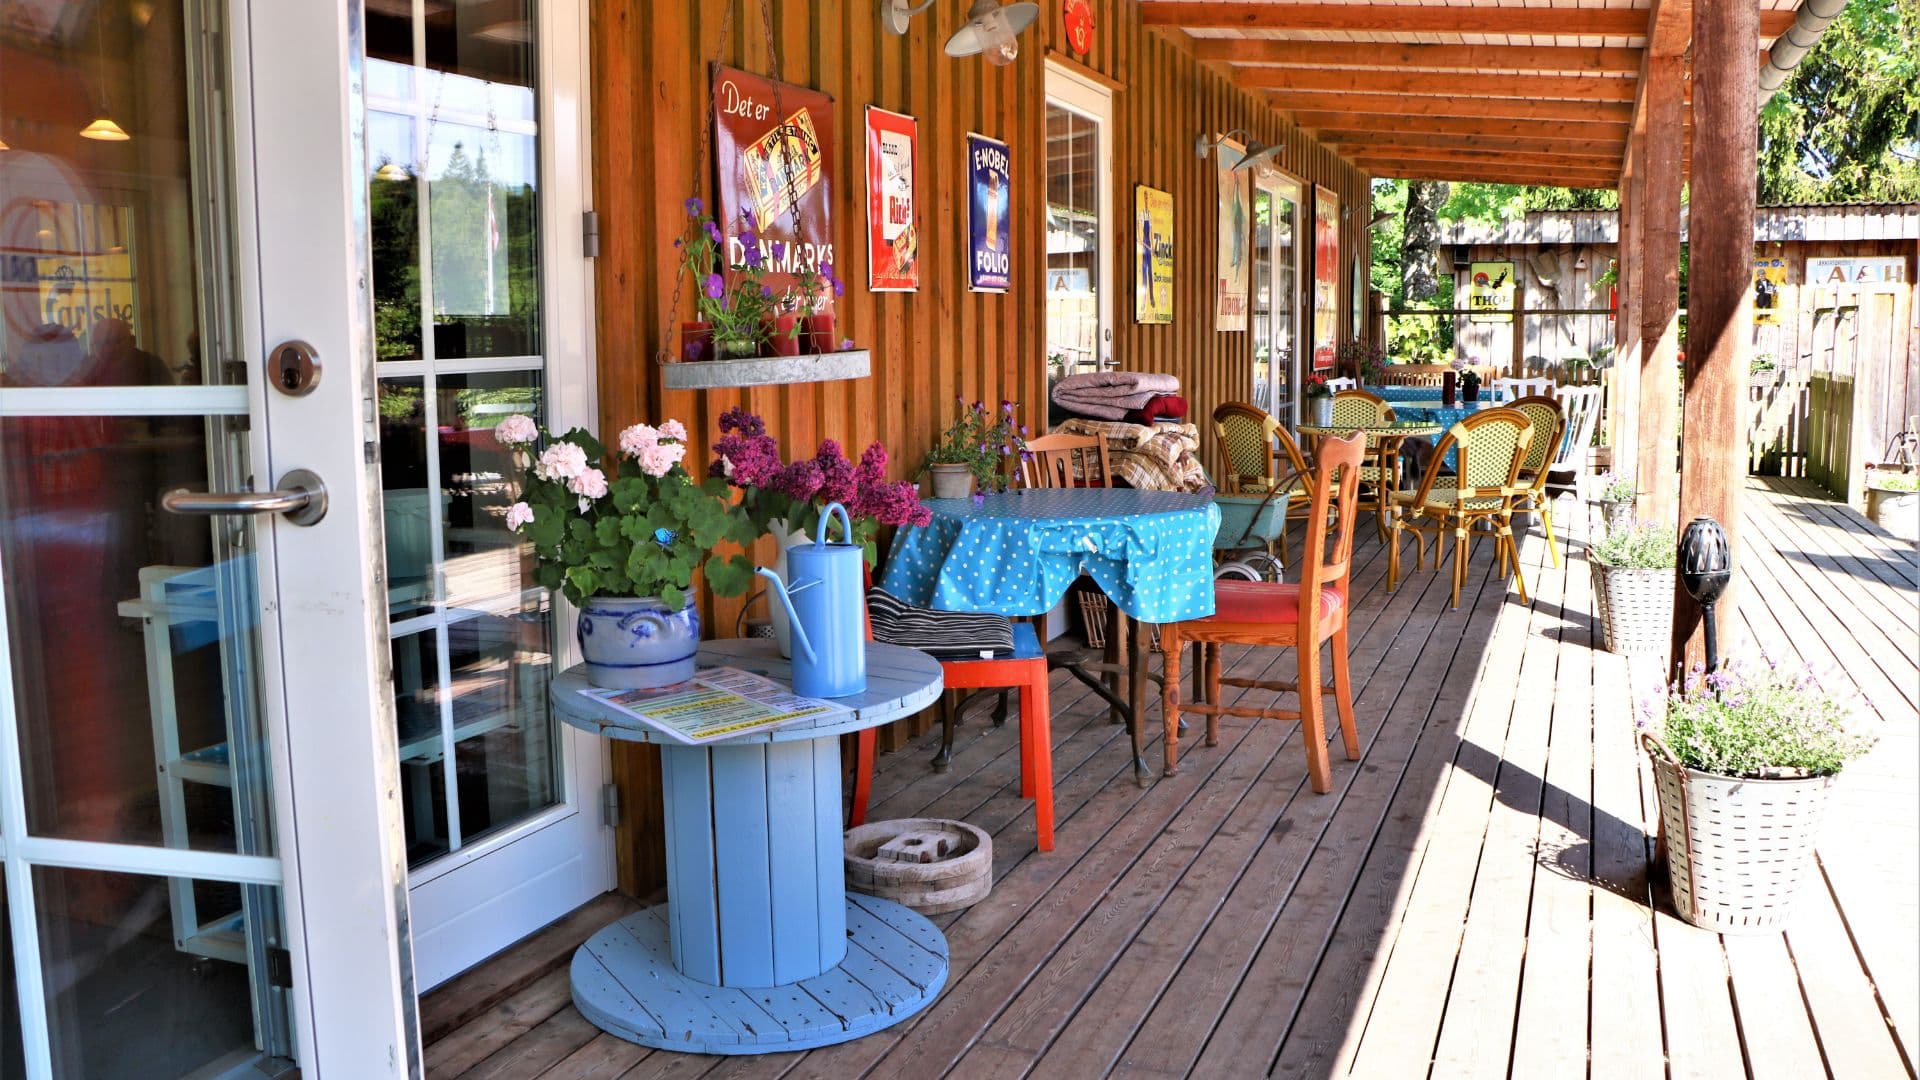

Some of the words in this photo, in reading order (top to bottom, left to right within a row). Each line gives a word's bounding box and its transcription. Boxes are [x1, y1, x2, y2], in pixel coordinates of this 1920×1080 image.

[722, 80, 753, 118] Det
[755, 103, 770, 121] er
[729, 236, 834, 274] DNMARKS
[977, 250, 1009, 274] FOLIO
